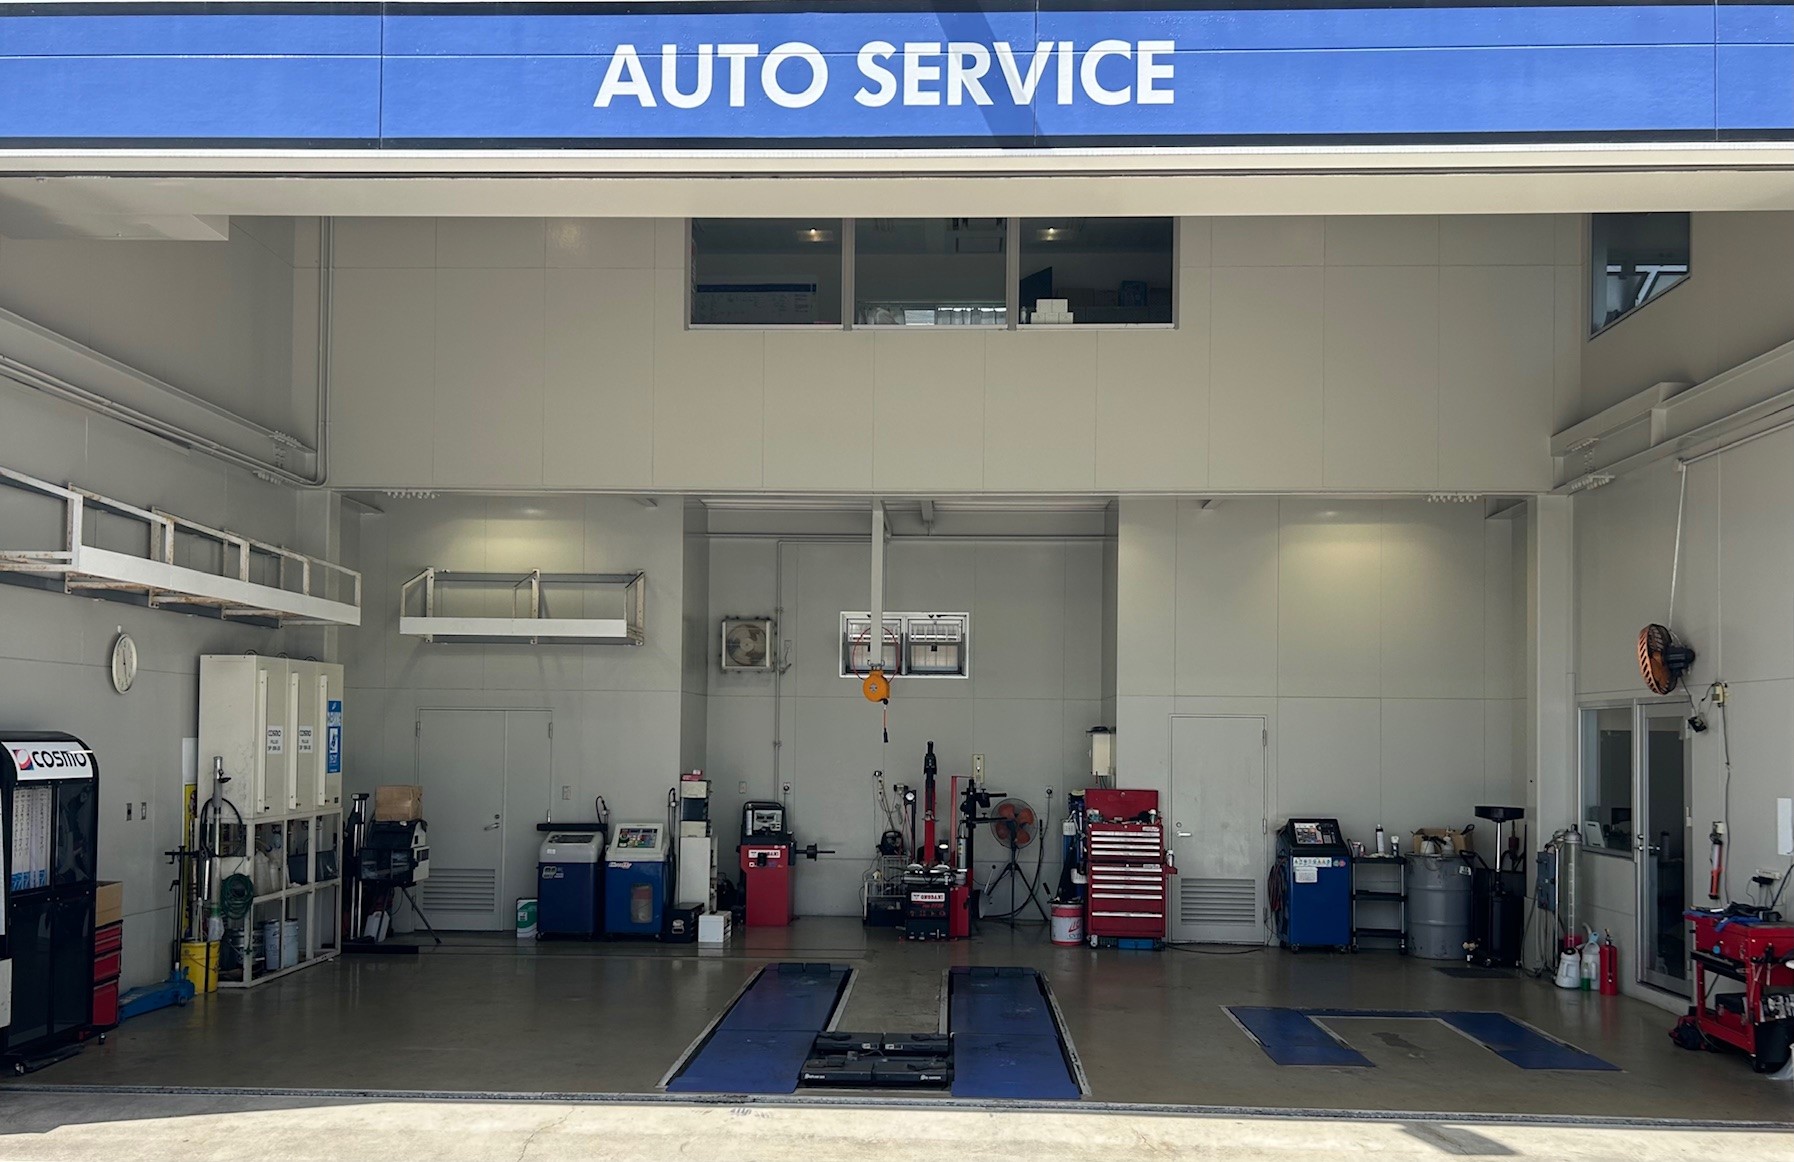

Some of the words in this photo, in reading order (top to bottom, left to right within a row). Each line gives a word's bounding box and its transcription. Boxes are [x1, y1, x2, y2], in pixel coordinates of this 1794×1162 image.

[593, 42, 829, 109] AUTO
[853, 40, 1177, 106] SERVICE
[31, 750, 87, 768] COSMO
